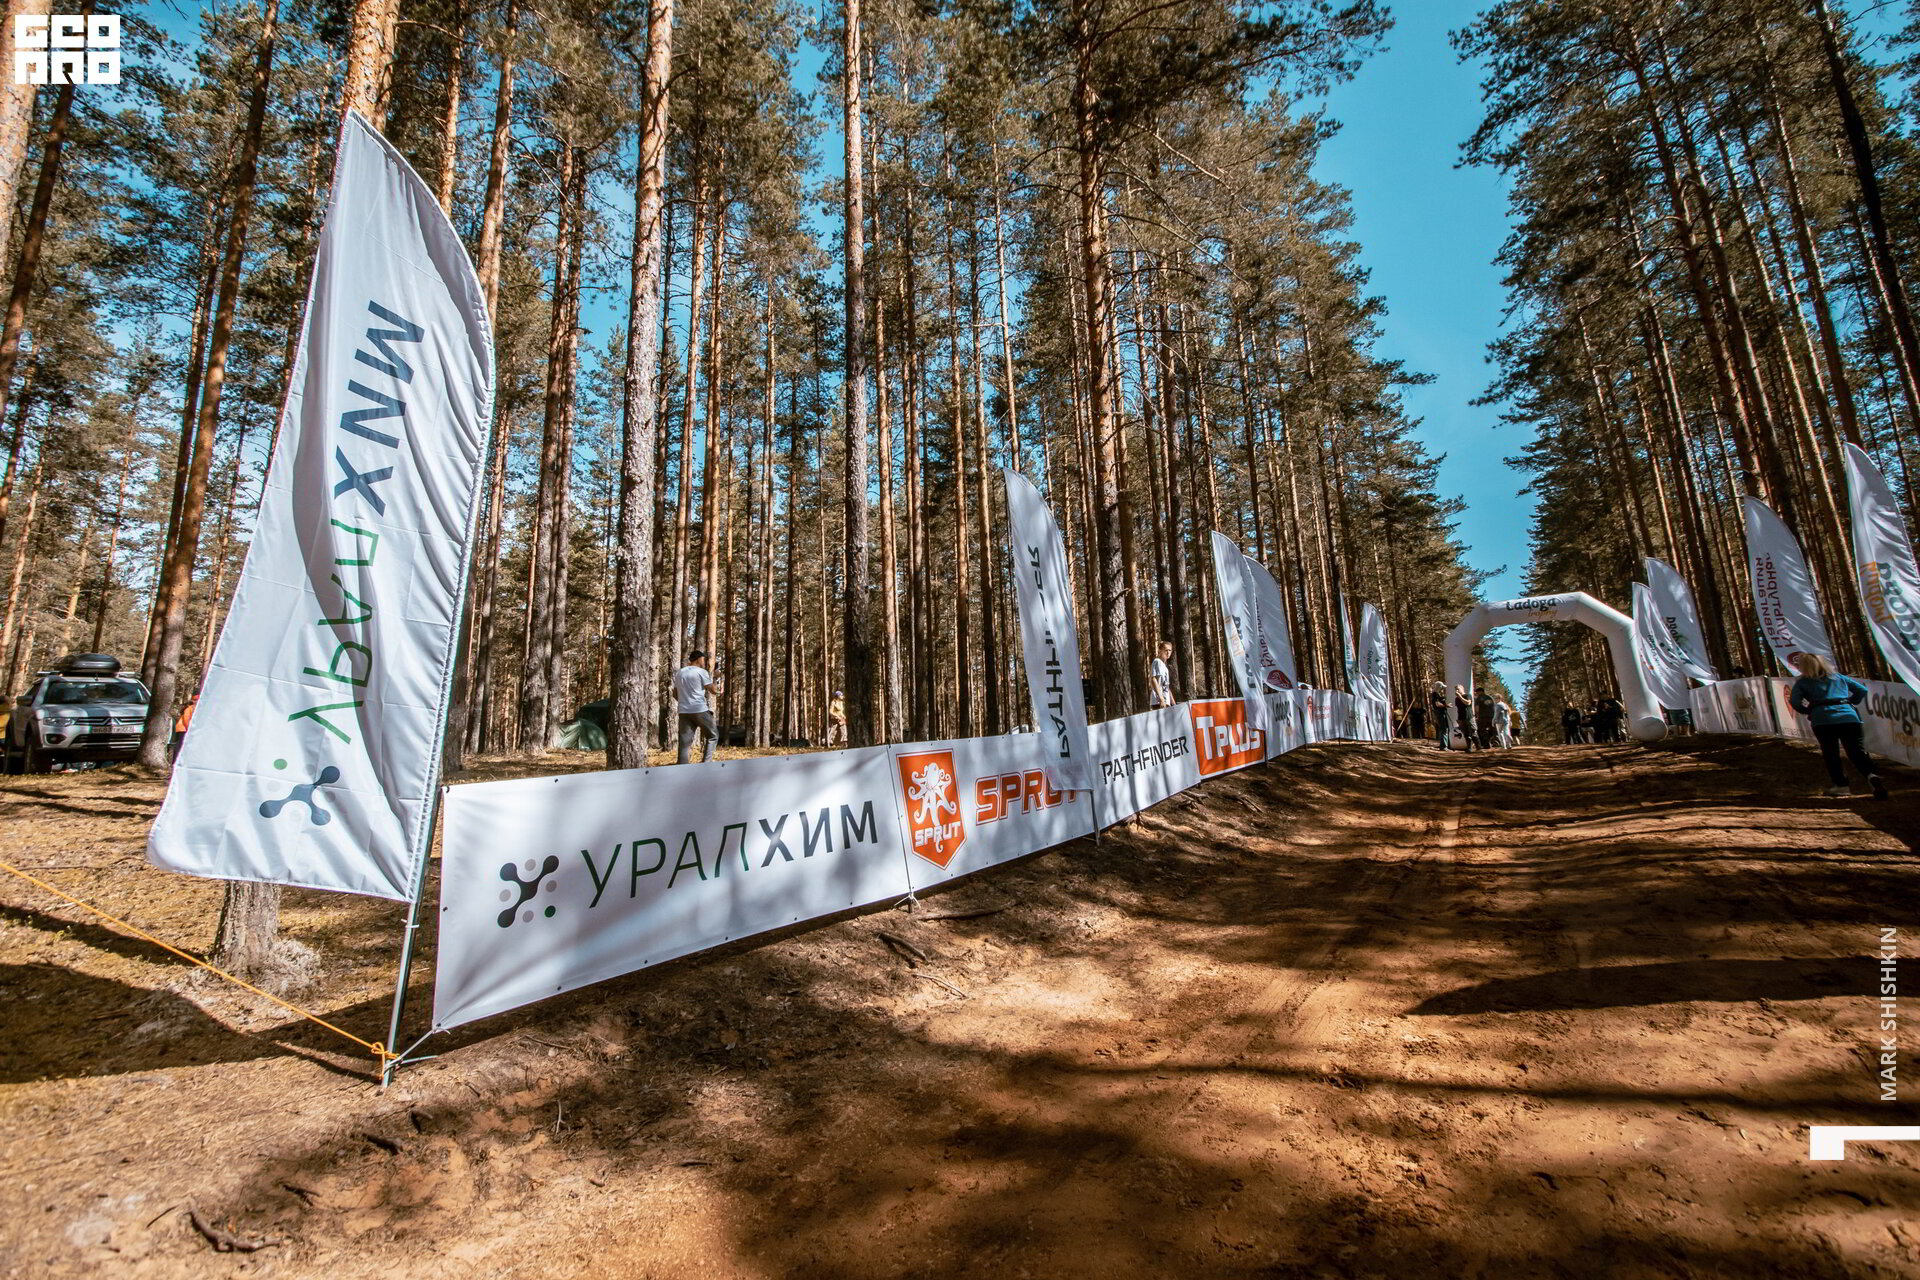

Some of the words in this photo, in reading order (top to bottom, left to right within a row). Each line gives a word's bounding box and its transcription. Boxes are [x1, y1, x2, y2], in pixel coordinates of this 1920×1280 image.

[1506, 598, 1557, 611] Ladoga
[1100, 735, 1189, 785] PATHFINDER
[975, 768, 1077, 826] SPRU
[580, 800, 878, 908] УРАЛХИМ
[915, 821, 960, 847] SPRUT
